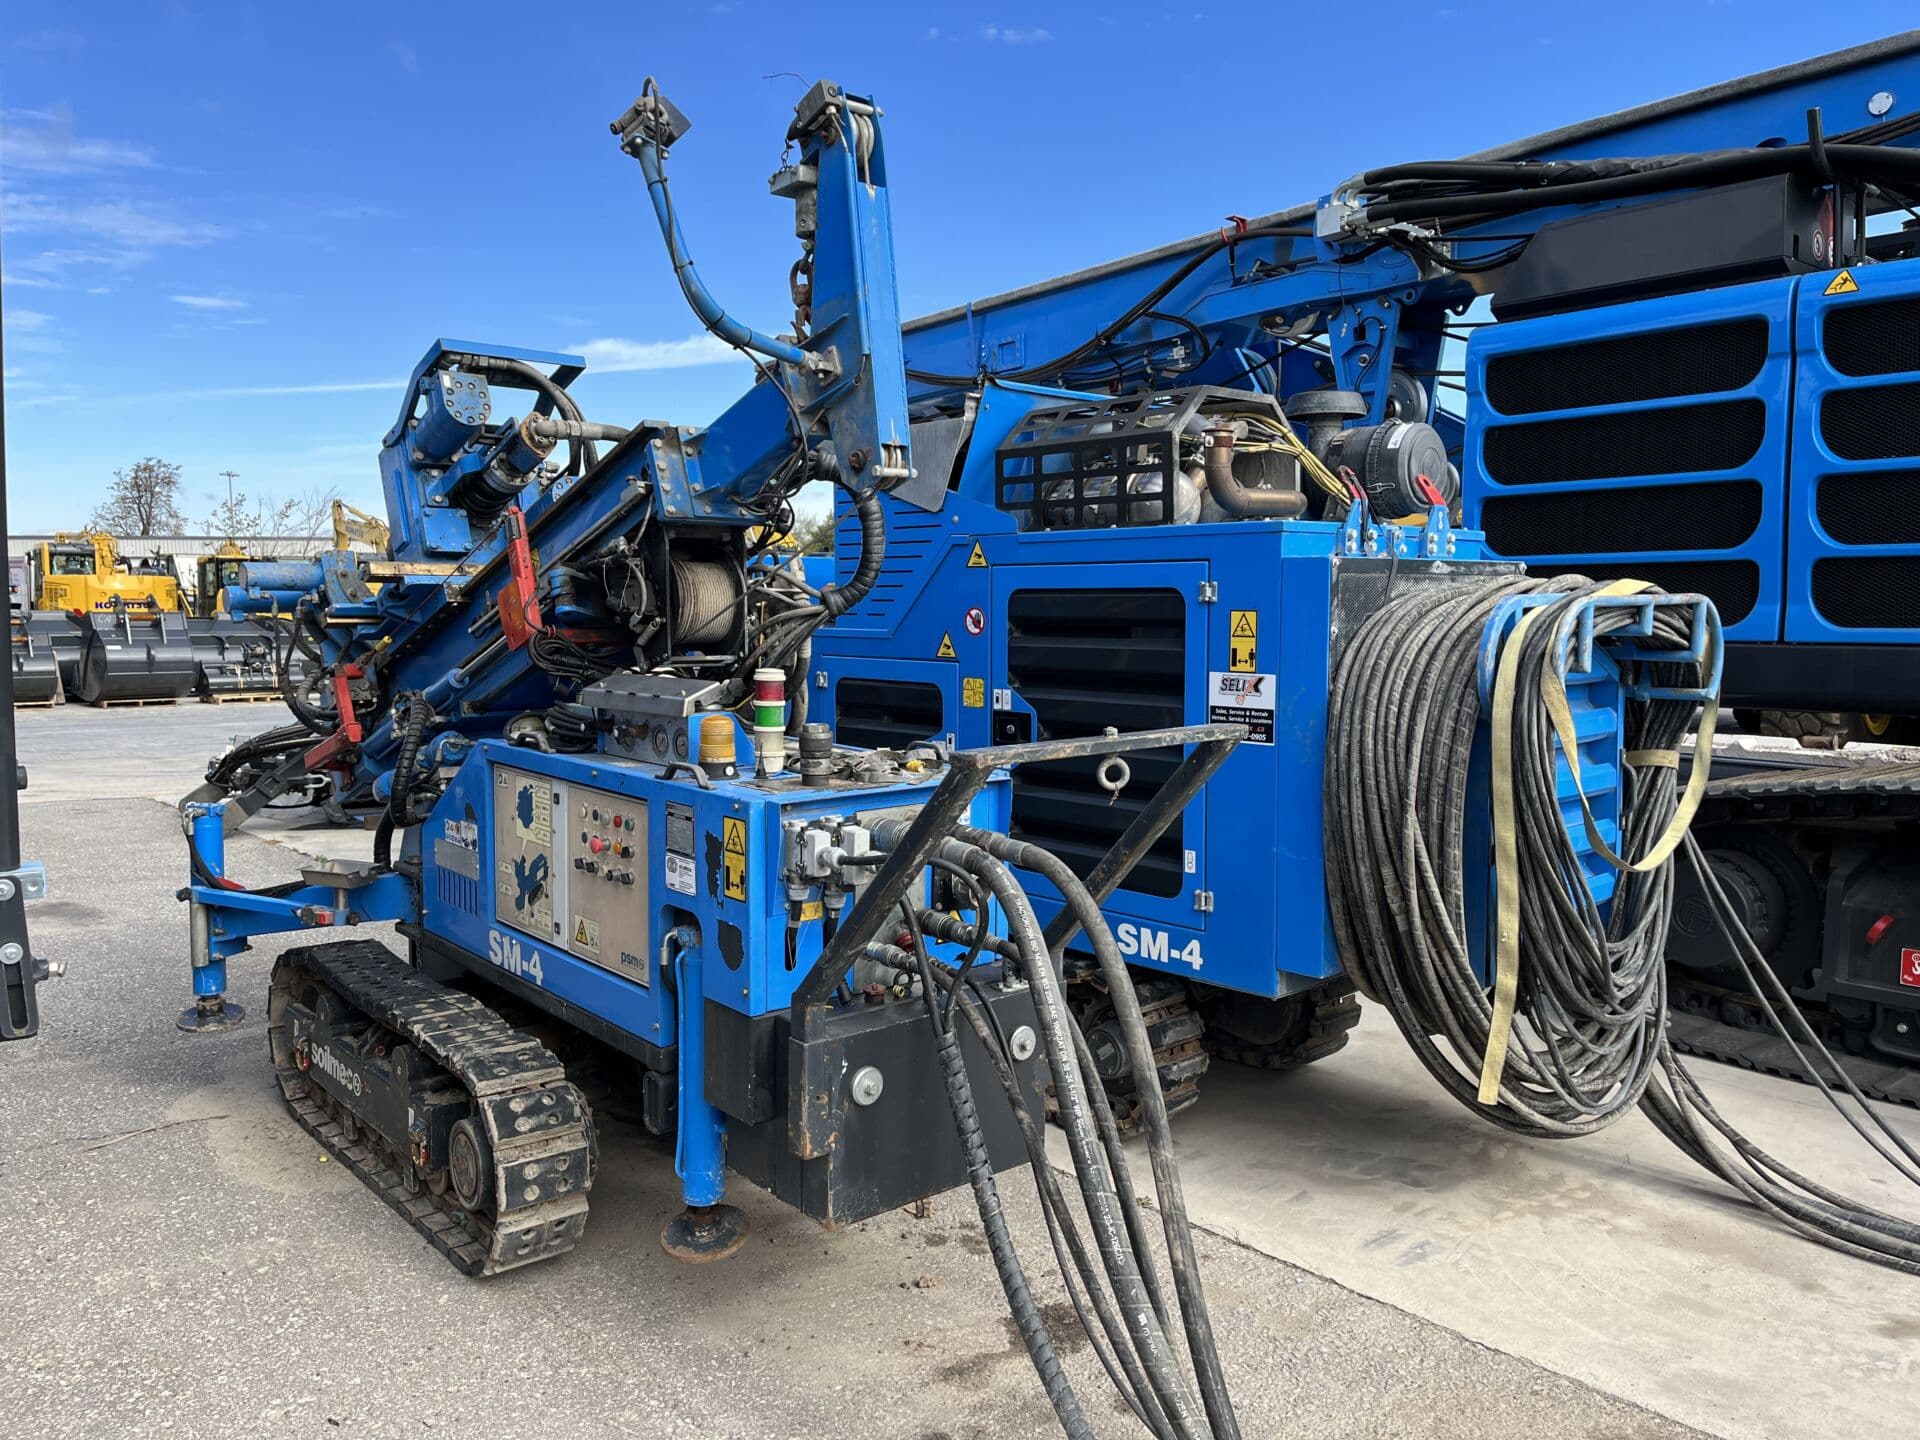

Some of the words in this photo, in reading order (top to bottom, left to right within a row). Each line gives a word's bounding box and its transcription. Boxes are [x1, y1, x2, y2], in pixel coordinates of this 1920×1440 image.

[488, 930, 543, 986] SM-4
[1118, 923, 1204, 970] SM-4
[1029, 939, 1039, 952] ISO
[1048, 1004, 1057, 1019] SAE
[1059, 1050, 1068, 1061] DN
